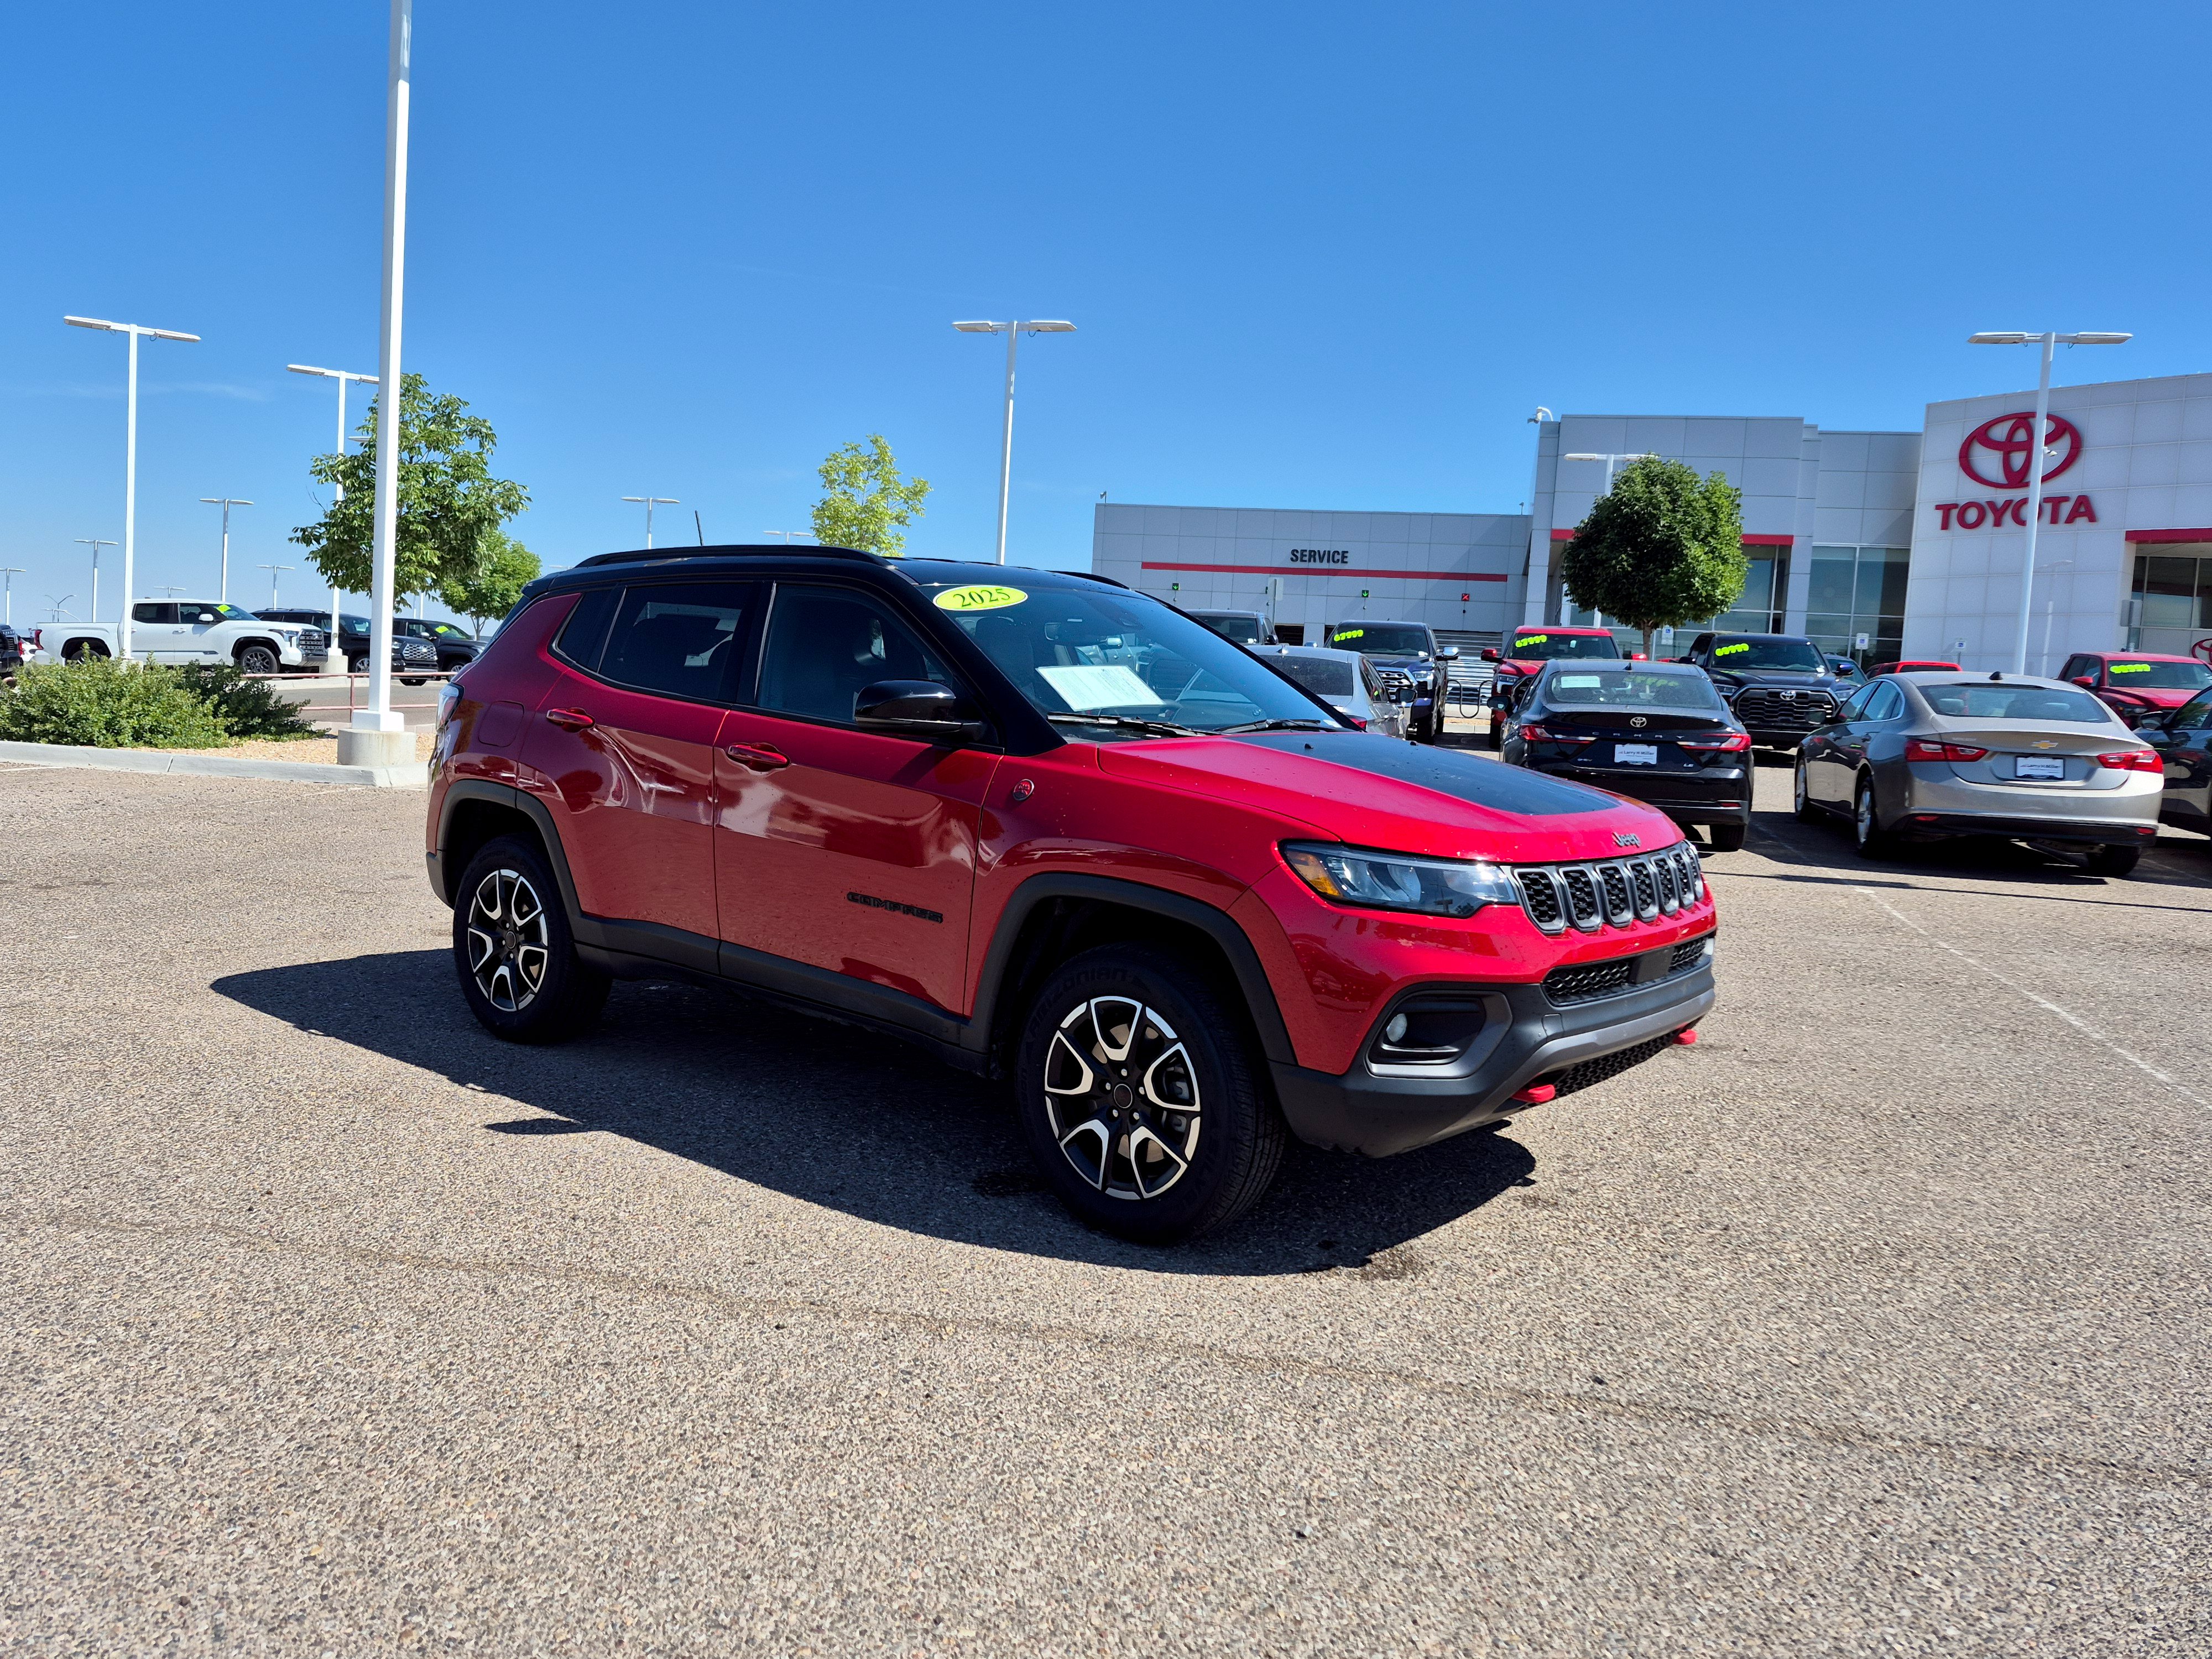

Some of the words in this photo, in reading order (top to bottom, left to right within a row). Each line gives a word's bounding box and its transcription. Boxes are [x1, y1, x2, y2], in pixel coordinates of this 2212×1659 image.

[1290, 549, 1349, 564] SERVICE
[953, 589, 1010, 607] 2025
[1611, 832, 1641, 848] Jeep
[847, 892, 943, 924] COMPASS
